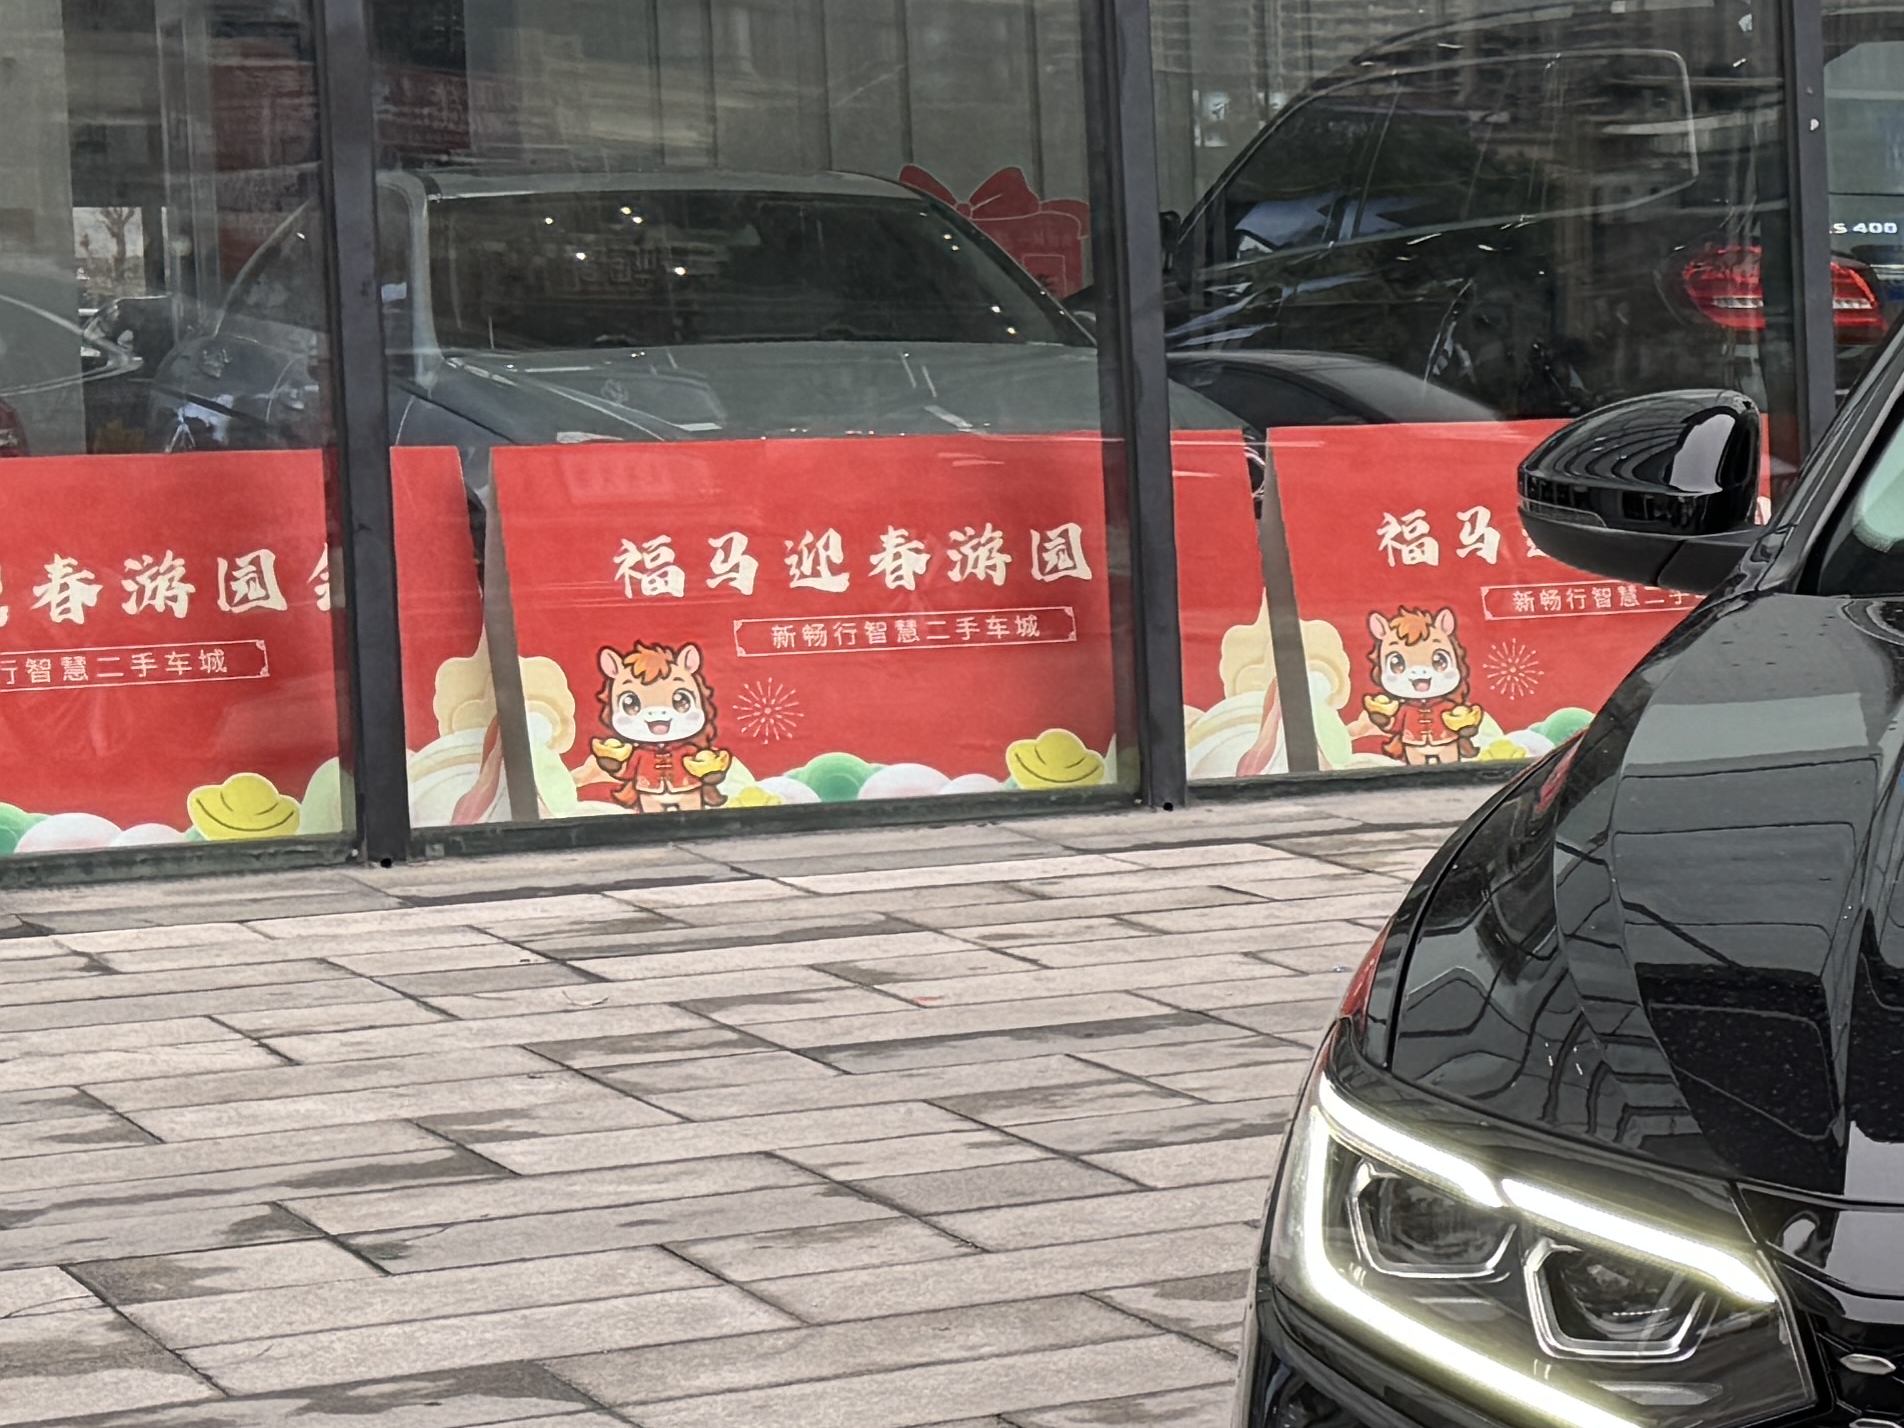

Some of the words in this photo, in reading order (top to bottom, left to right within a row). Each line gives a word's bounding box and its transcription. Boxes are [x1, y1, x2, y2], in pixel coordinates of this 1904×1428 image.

[1829, 222, 1848, 234] S
[1853, 222, 1897, 234] 400
[613, 522, 1093, 598] 福马迎春游园
[1376, 505, 1550, 568] 福马
[0, 543, 331, 627] 春游园
[1511, 584, 1705, 613] 新畅行智慧二手
[771, 614, 1041, 649] 新畅行智慧二手车城
